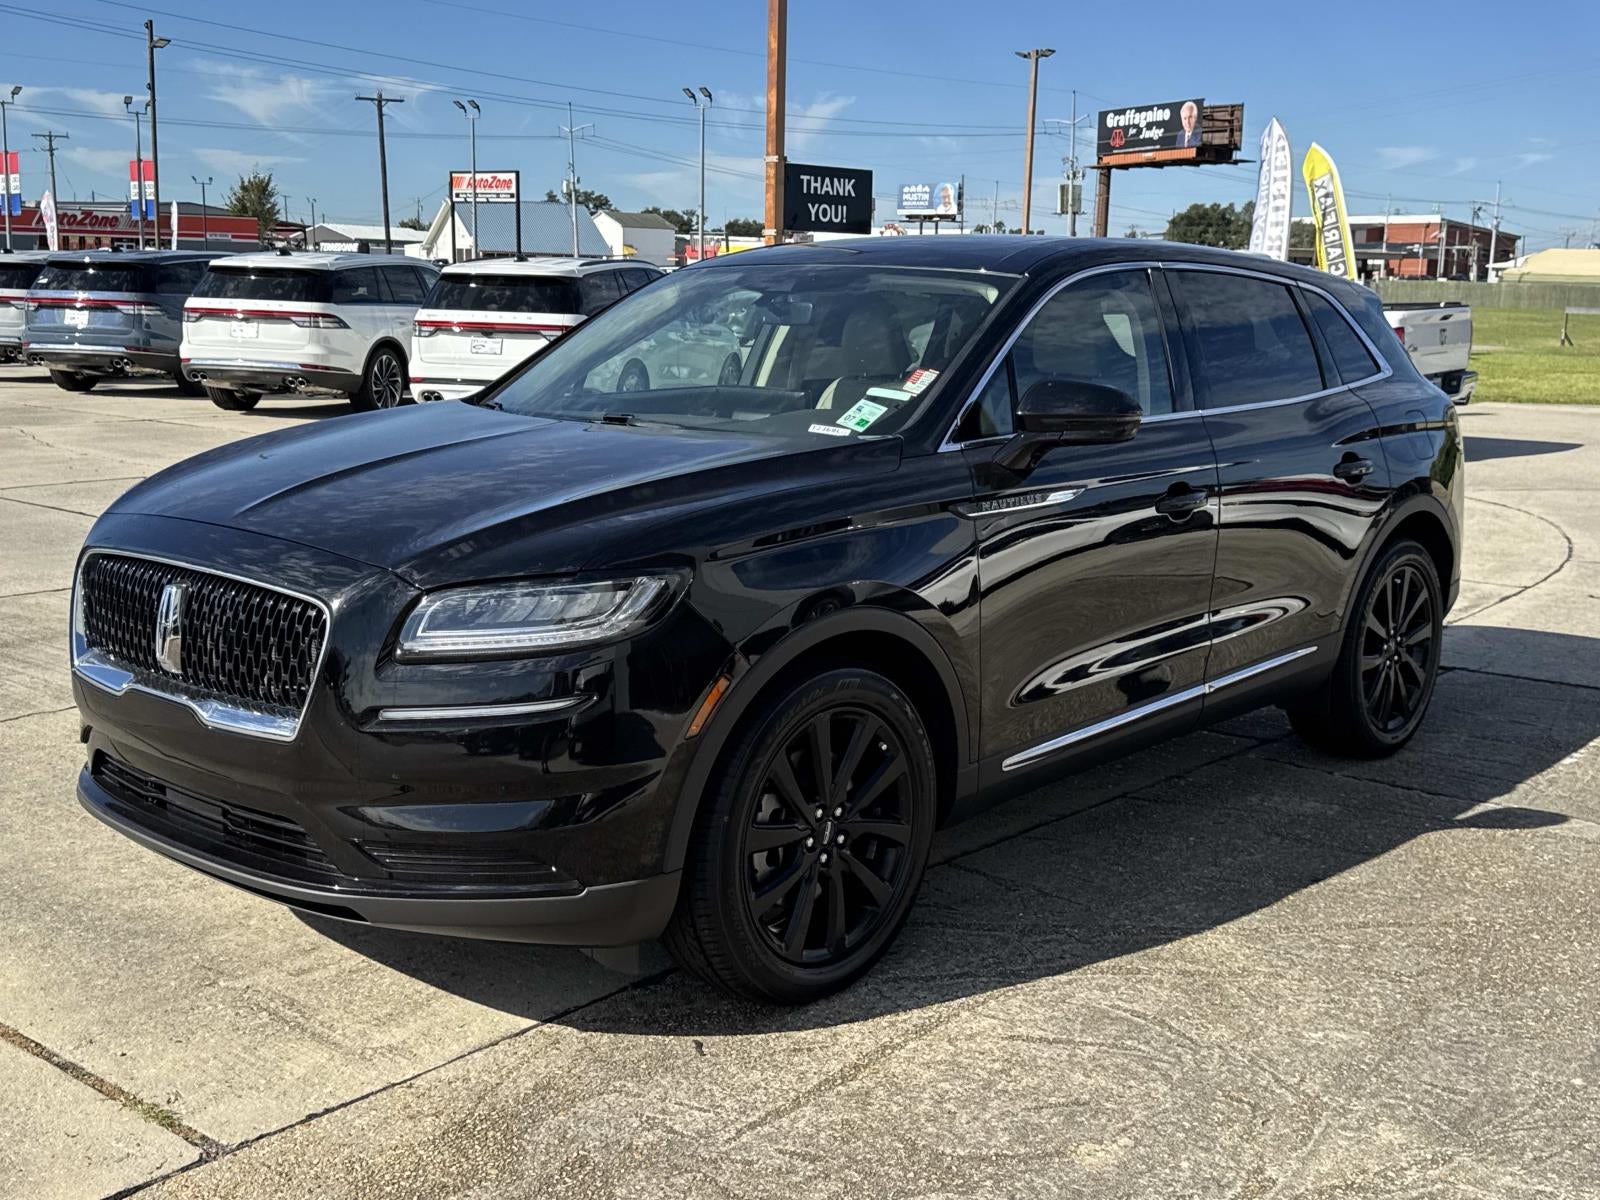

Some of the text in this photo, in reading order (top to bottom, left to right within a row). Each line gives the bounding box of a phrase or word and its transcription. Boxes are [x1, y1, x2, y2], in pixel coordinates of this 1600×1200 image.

[1106, 106, 1171, 128] Graffagnino
[1139, 125, 1165, 140] Judge
[800, 175, 856, 197] THANK
[807, 203, 847, 223] YOU!
[982, 493, 1041, 511] NAUTILUS
